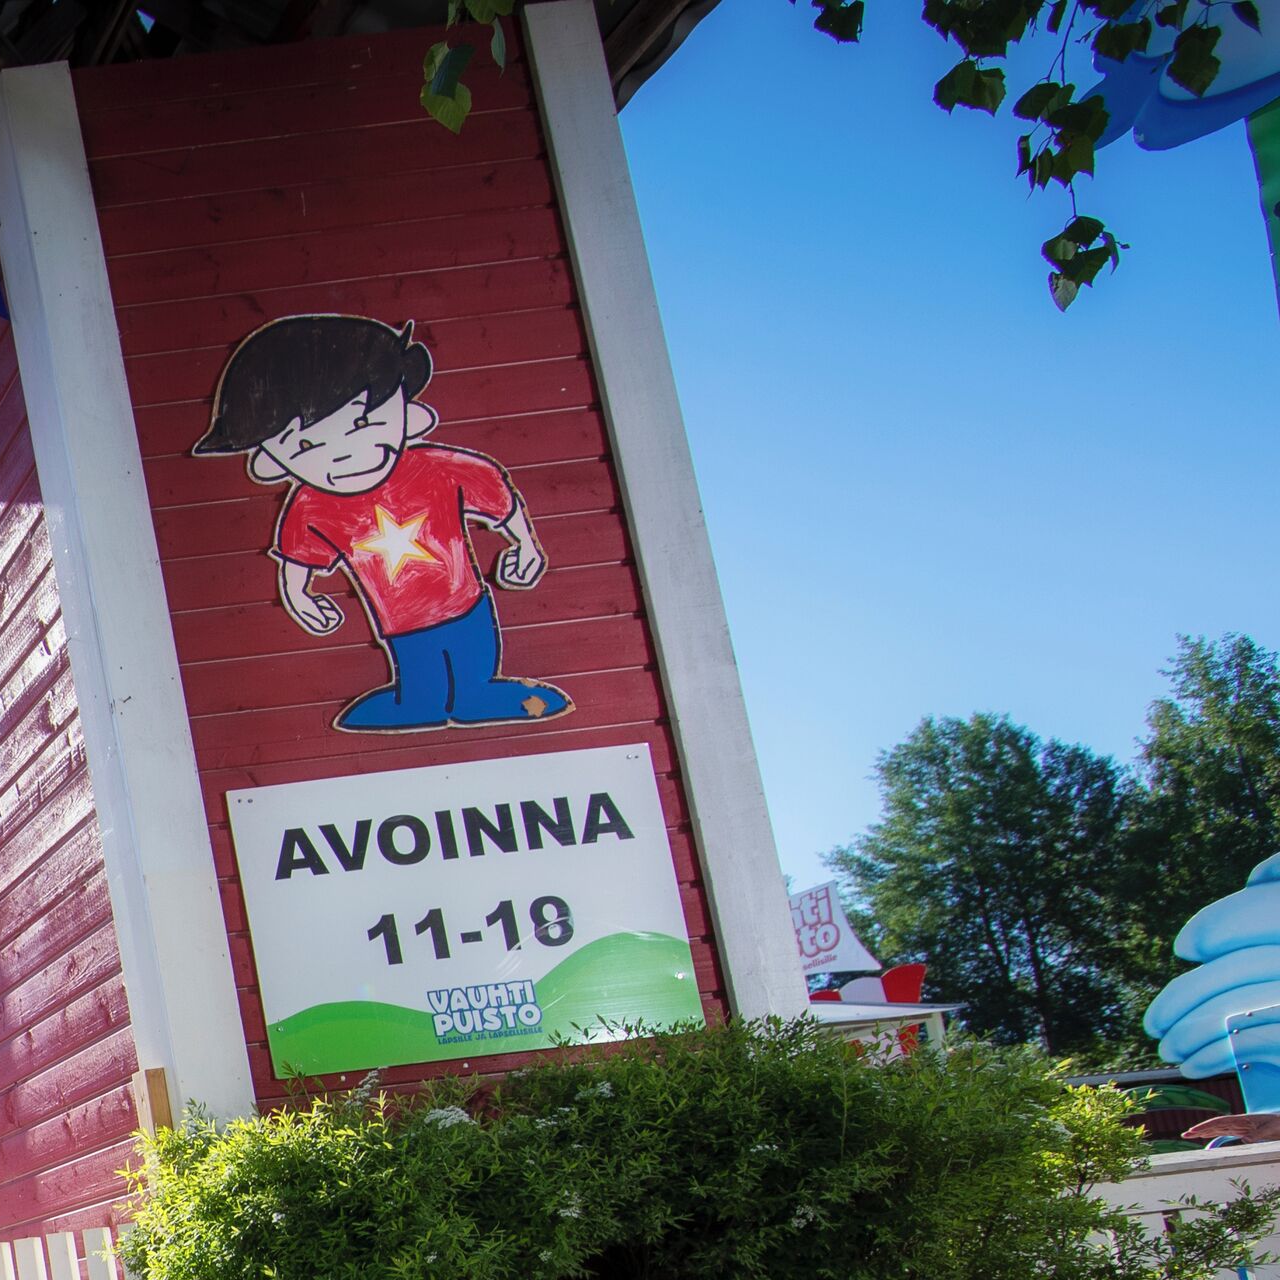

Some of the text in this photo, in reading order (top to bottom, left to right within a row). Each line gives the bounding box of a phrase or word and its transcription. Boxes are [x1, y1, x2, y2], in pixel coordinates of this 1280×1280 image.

[275, 792, 634, 880] AVOINNA
[367, 895, 575, 965] 11-18
[427, 979, 536, 1014] VAUHTI
[433, 1003, 543, 1037] PUISTO
